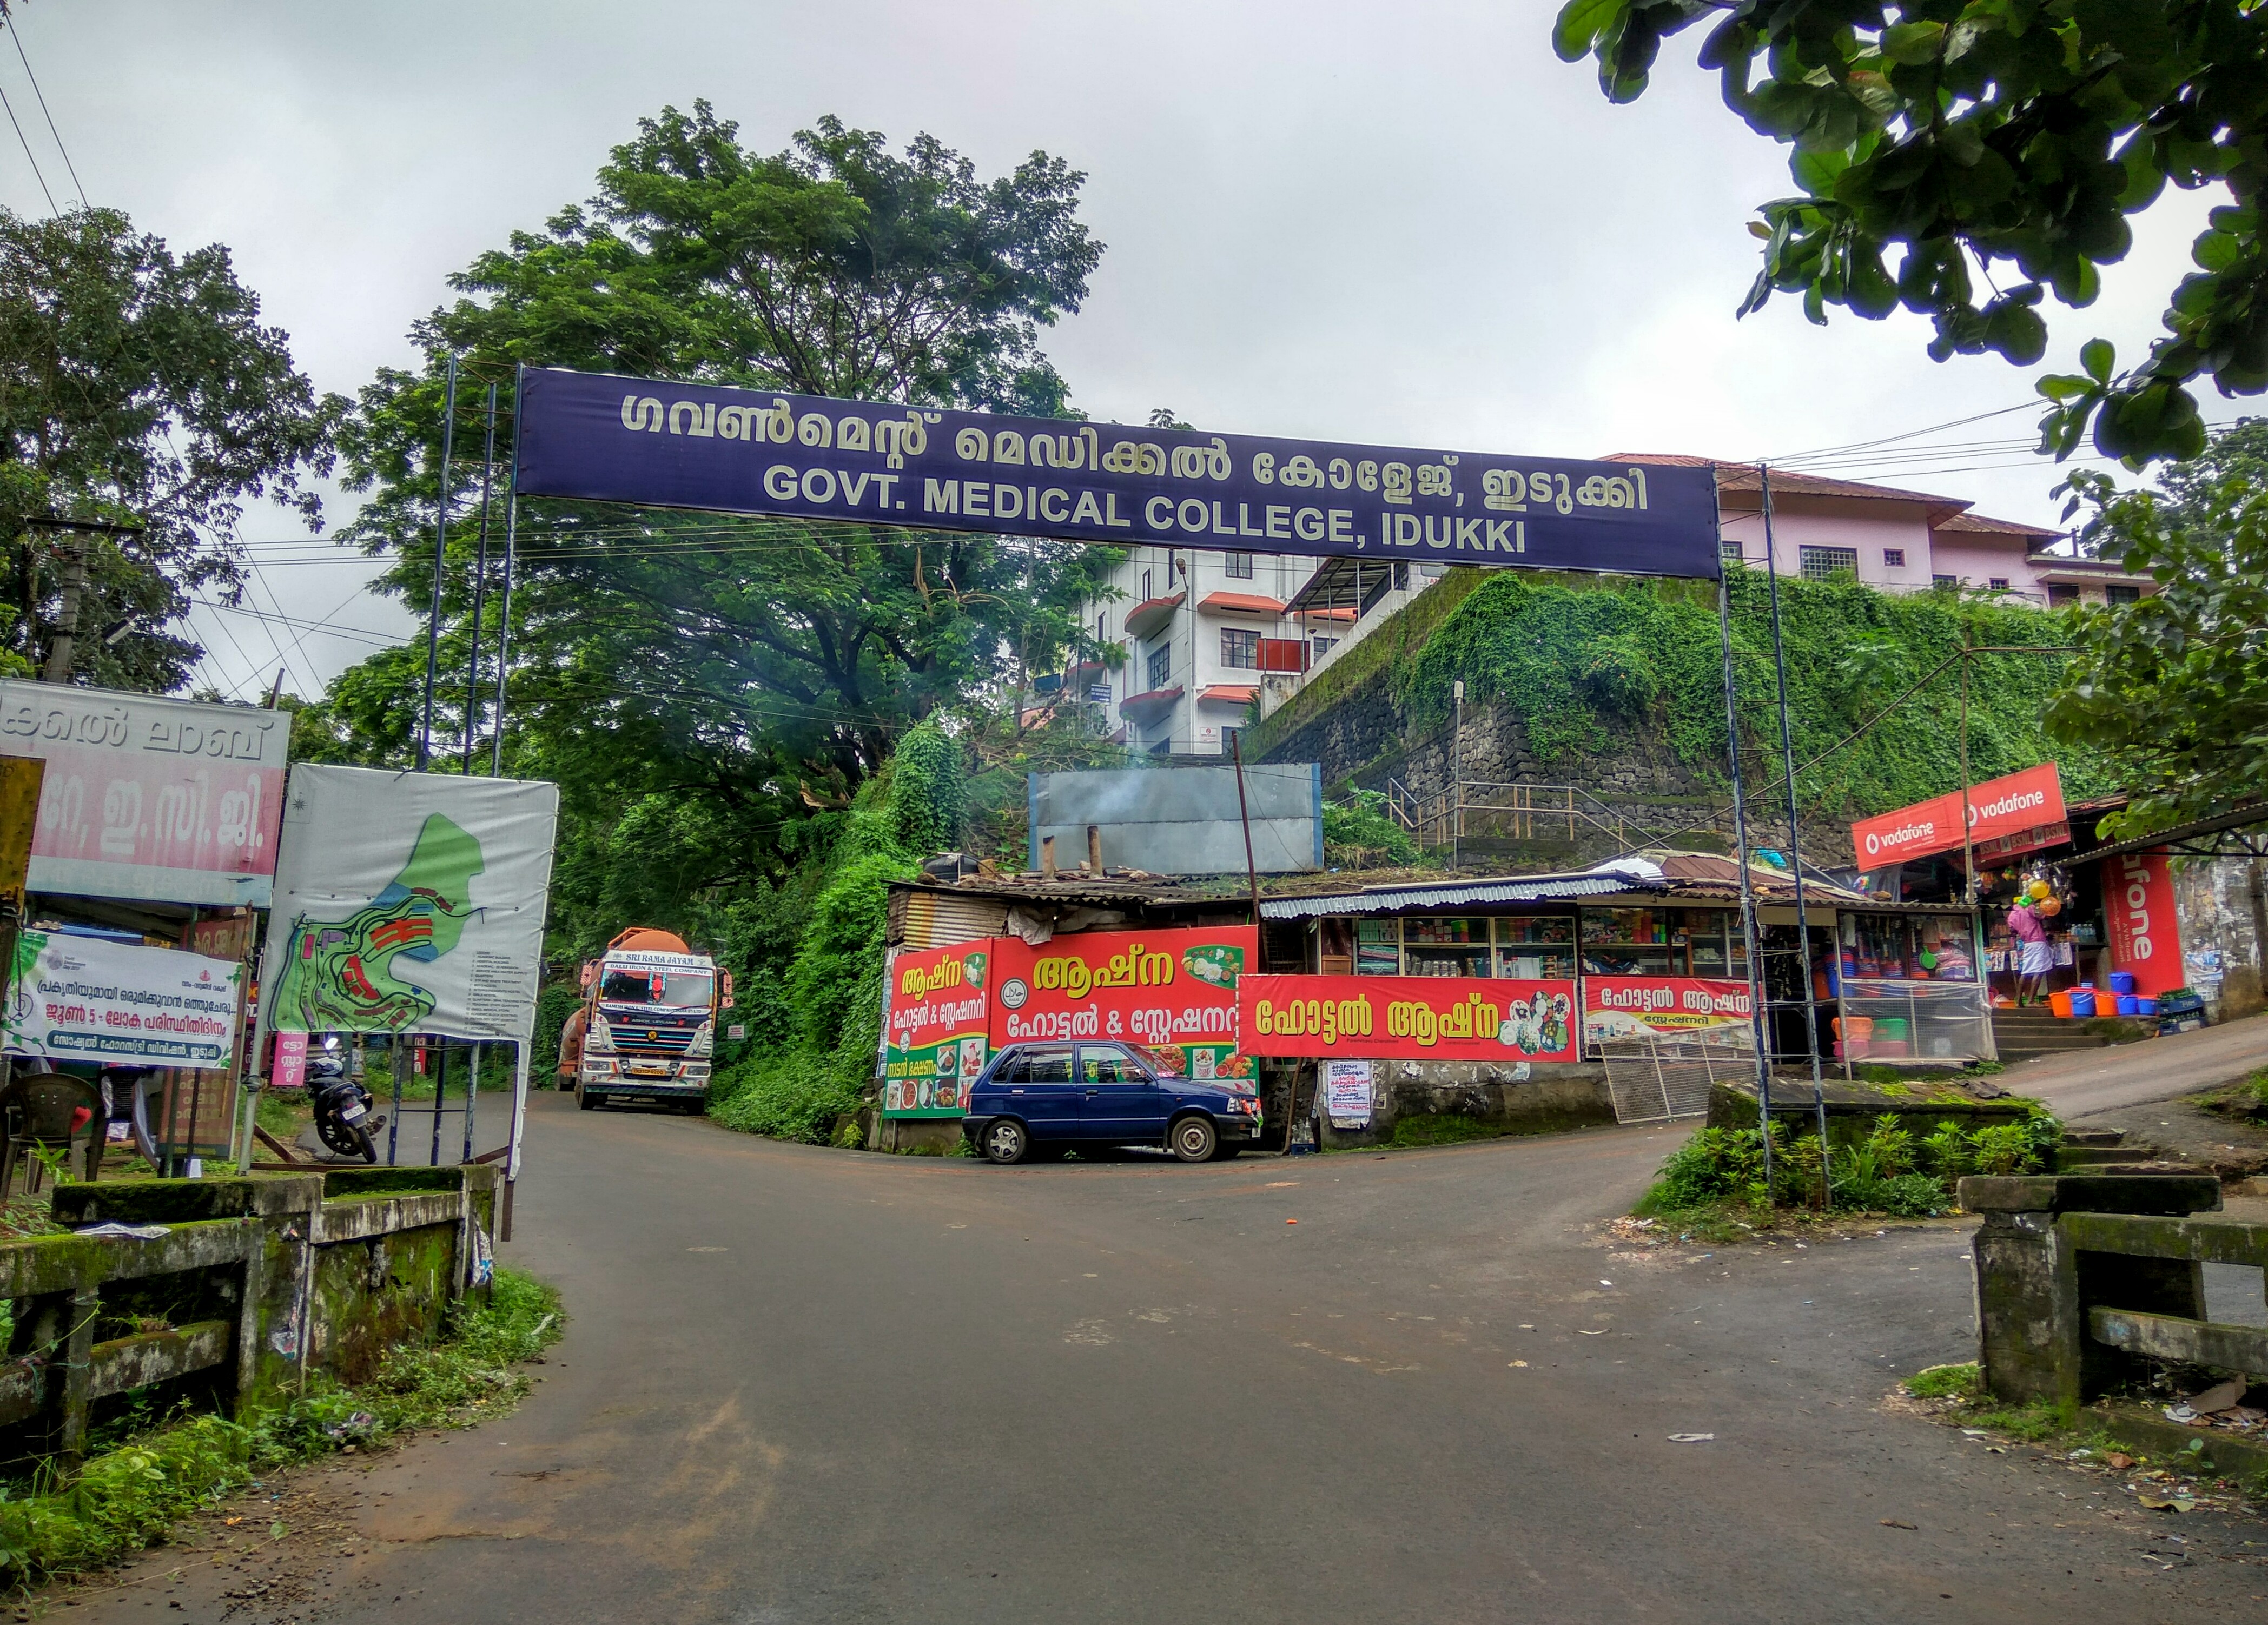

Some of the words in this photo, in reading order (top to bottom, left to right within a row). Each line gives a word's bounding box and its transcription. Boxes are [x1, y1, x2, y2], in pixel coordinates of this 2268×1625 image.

[955, 427, 1231, 481] മെഡിക്കൽ
[1253, 452, 1464, 507] കോളേജ്,
[1483, 467, 1648, 514] ഇടുക്കി
[763, 465, 905, 509] GOVT.
[924, 478, 1130, 527] MEDICAL
[1145, 496, 1365, 549] COLLEGE,
[1383, 512, 1525, 553] IDUKKI
[0, 706, 129, 747] ക്കൽ
[143, 720, 274, 761] ലാബ്
[1980, 791, 2044, 819] vodafone
[1881, 821, 1934, 847] vodafone
[1980, 840, 2000, 855] BSNL
[2012, 833, 2033, 847] BSNL
[2045, 824, 2067, 840] BSNL
[626, 953, 640, 961] SRI
[642, 954, 666, 963] RAMA
[667, 956, 693, 965] JAYAM
[1033, 944, 1174, 999] ആഷ്ന
[37, 979, 118, 1000] പ്രകൃതിയുമായി
[120, 990, 182, 1008] ഒരുമിക്കുവാൻ
[902, 954, 961, 1001] ആഷ്ന
[894, 999, 929, 1033] ഹോട്ടൽ
[930, 1005, 937, 1025] &
[939, 990, 986, 1031] സ്റ്റേഷനറി
[1601, 986, 1674, 1012] ഹോട്ടൽ
[1683, 989, 1750, 1014] ആഷ്ന
[45, 1003, 85, 1026] ജൂൺ
[89, 1008, 96, 1024] 5
[105, 1010, 141, 1029] ലോക
[144, 1012, 227, 1037] പരിസ്ഥിതിദിനം
[1007, 1003, 1099, 1041] ഹോട്ടൽ
[1106, 1010, 1123, 1035] &
[1255, 993, 1373, 1045] ഹോട്ടൽ
[1387, 992, 1499, 1046] ആഷ്ന
[1644, 1014, 1709, 1025] സ്റ്റേഷനറി
[53, 1034, 97, 1050] സോഷ്യൽ
[887, 1057, 908, 1078] നാടൻ
[909, 1059, 937, 1077] ഭക്ഷണം
